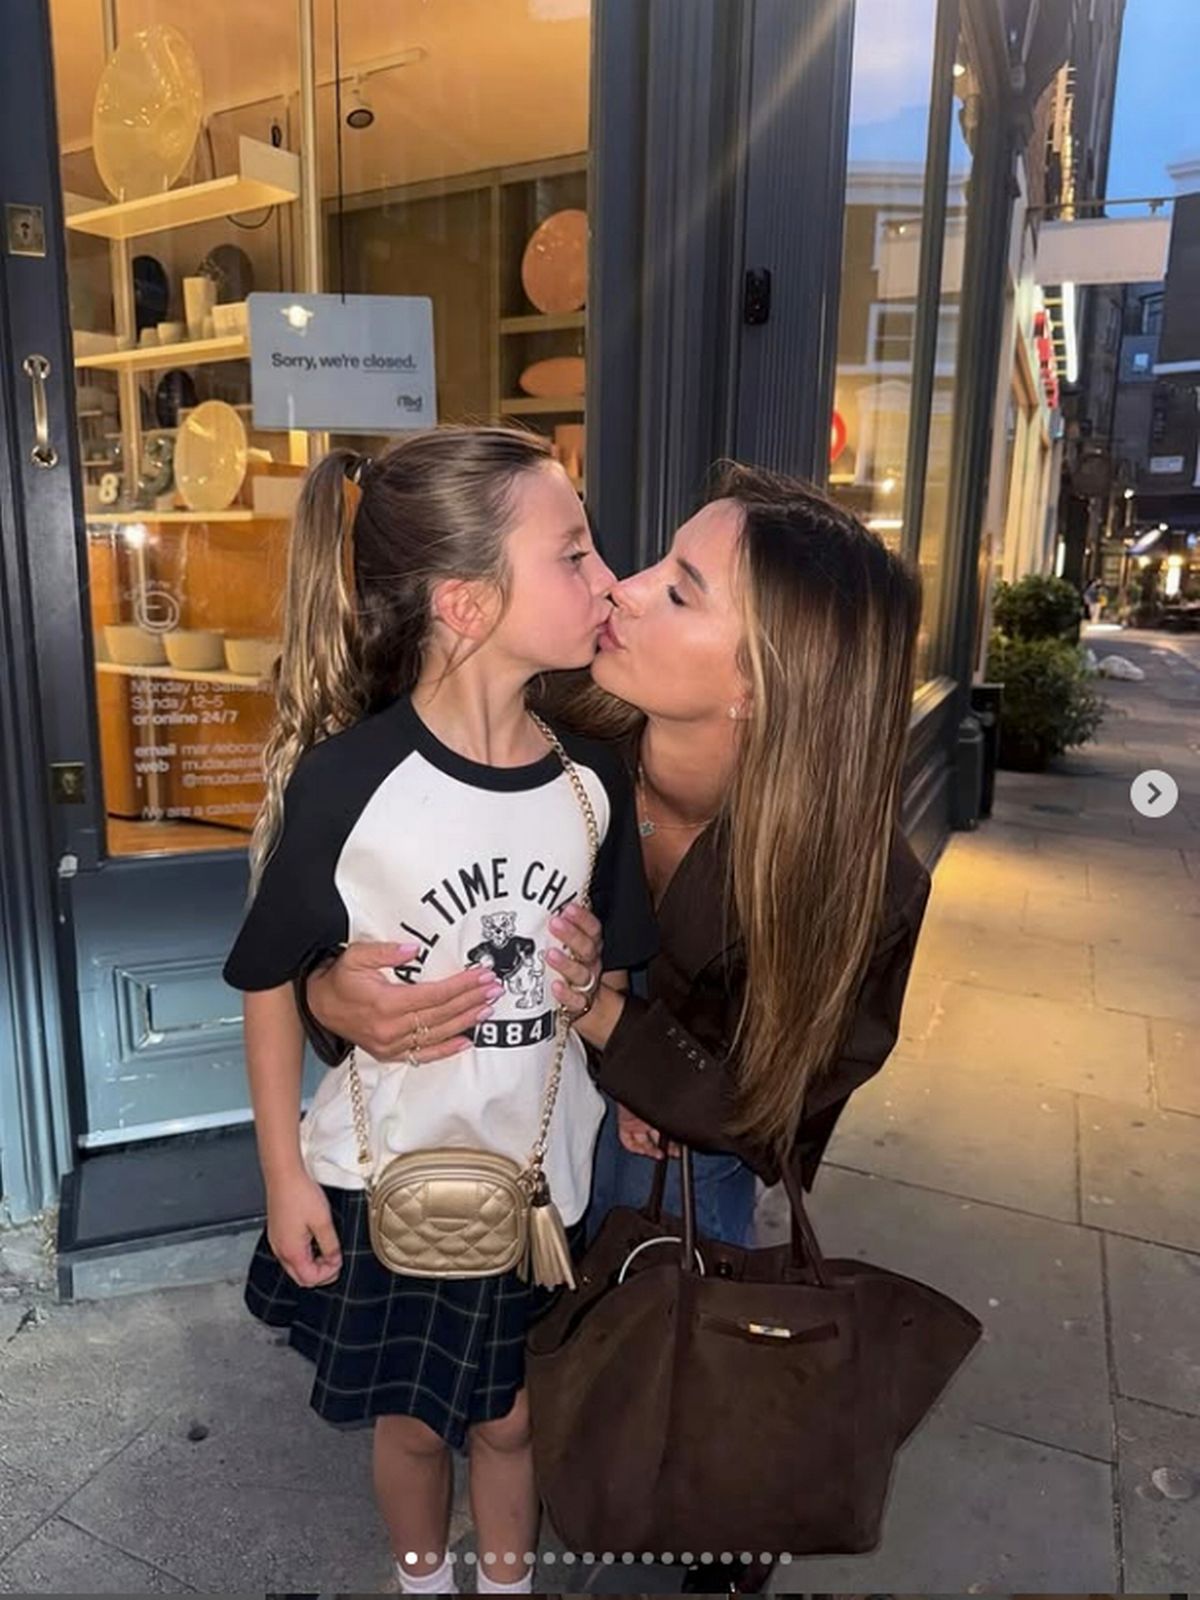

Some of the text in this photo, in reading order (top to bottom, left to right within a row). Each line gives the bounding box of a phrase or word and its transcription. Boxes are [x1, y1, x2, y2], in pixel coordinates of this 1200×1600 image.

[272, 353, 417, 371] Sorry, we're closed.
[131, 680, 191, 695] Monday
[194, 681, 208, 692] to
[152, 713, 198, 725] online
[201, 710, 239, 724] 24/7
[134, 743, 177, 757] email
[135, 760, 170, 773] web
[421, 857, 509, 925] TIME
